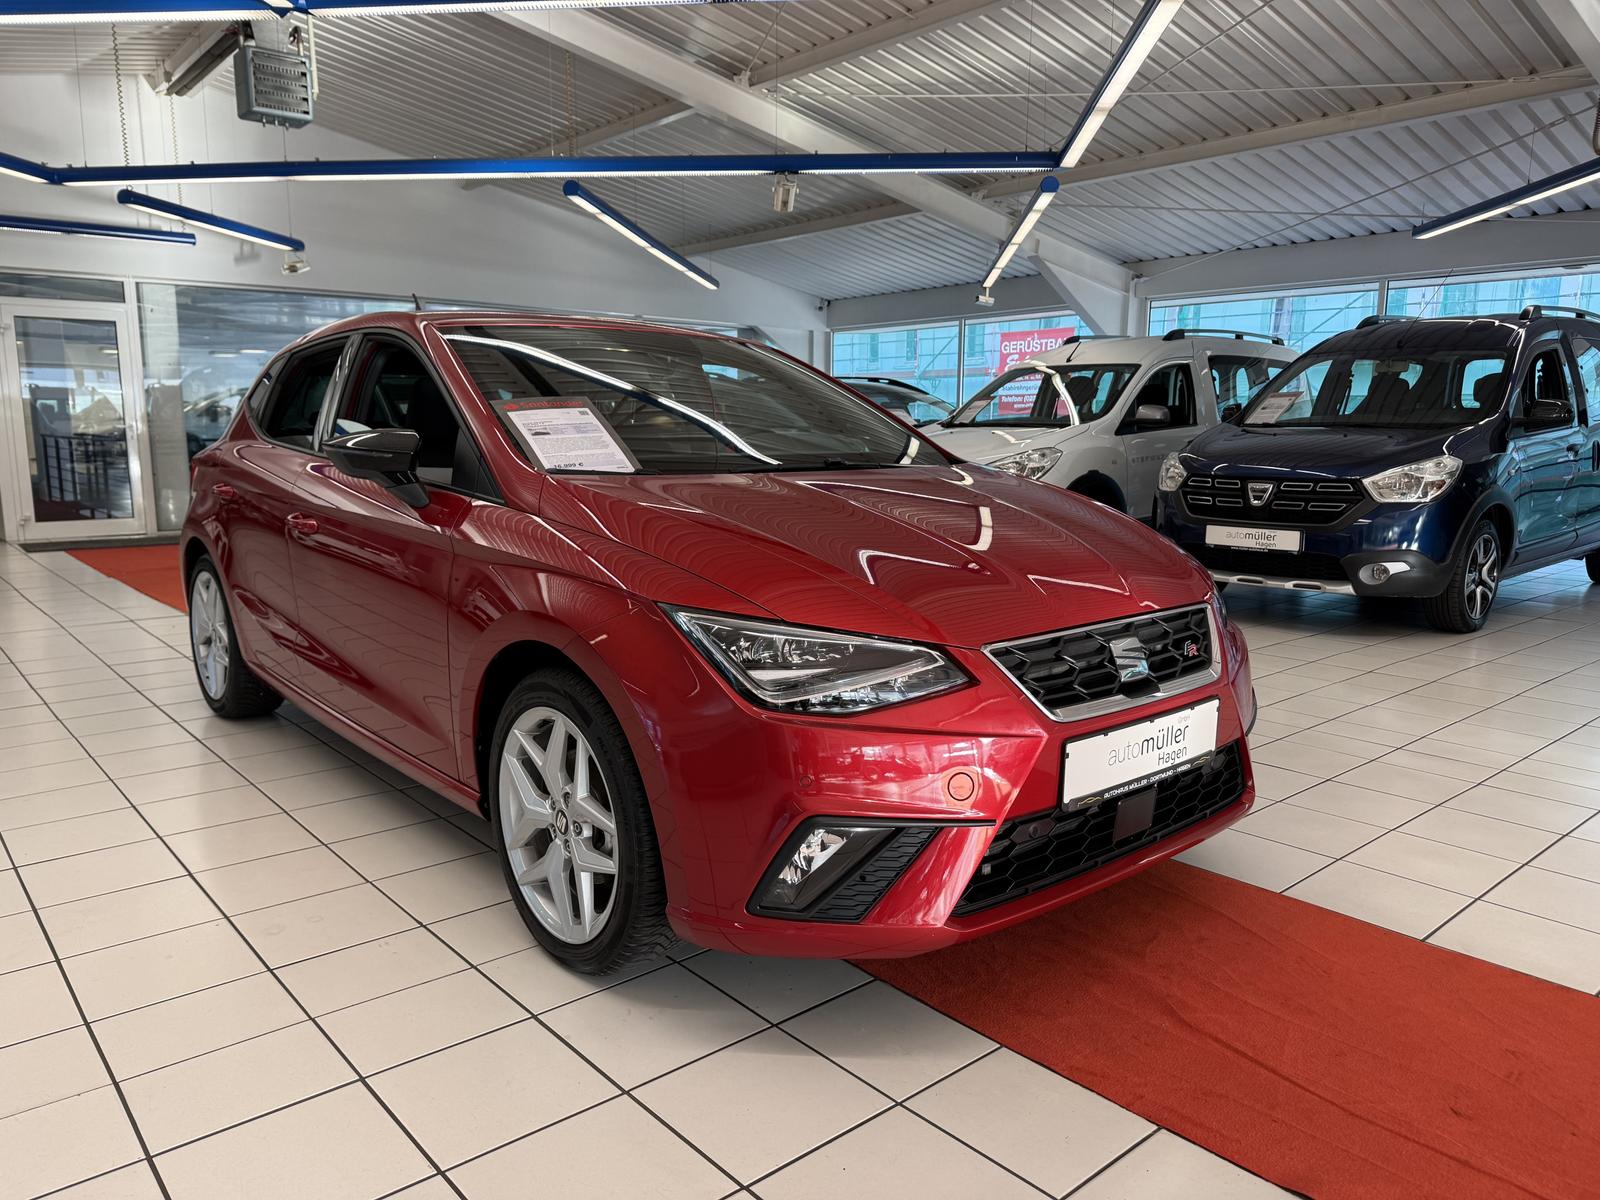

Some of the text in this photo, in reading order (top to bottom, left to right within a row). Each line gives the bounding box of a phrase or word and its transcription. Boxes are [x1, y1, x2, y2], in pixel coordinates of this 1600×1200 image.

[1001, 337, 1066, 353] GERÜSTBA
[1225, 531, 1277, 541] automüller
[1255, 540, 1277, 549] Hagen
[1108, 725, 1189, 766] automüller
[1157, 746, 1188, 766] Hagen
[1103, 763, 1192, 799] AUTOHAUS MÜLLER DORTMUND HAGEN
